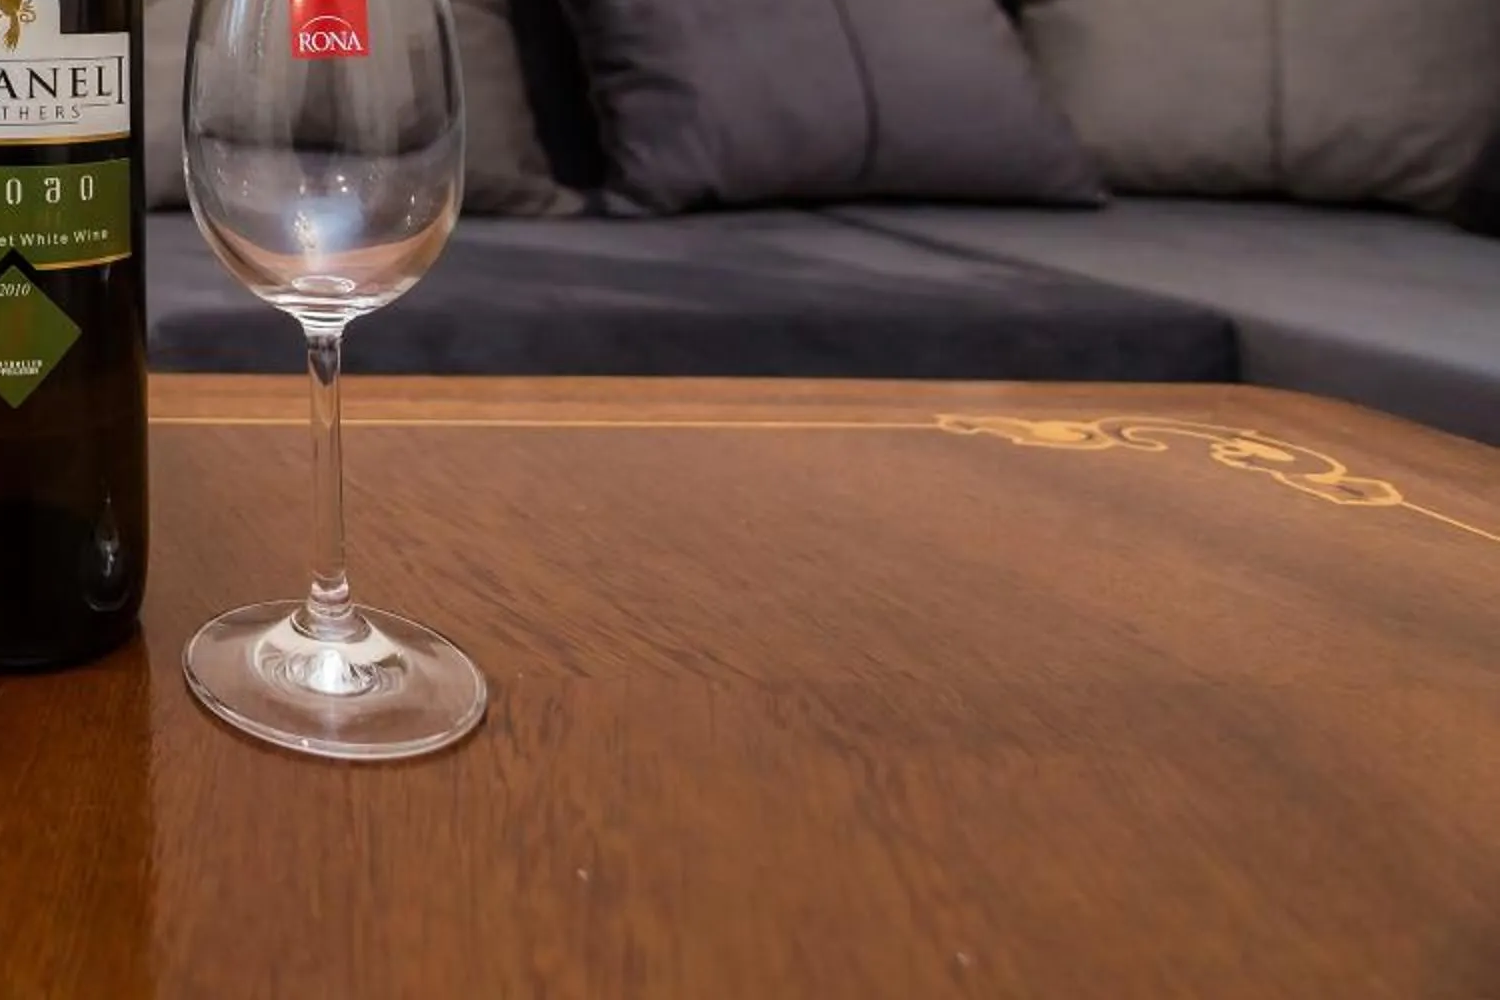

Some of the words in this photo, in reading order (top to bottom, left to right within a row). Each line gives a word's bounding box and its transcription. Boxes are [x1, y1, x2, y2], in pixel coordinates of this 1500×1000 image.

[299, 30, 364, 53] RONA
[20, 231, 69, 247] White
[73, 228, 109, 243] Wine
